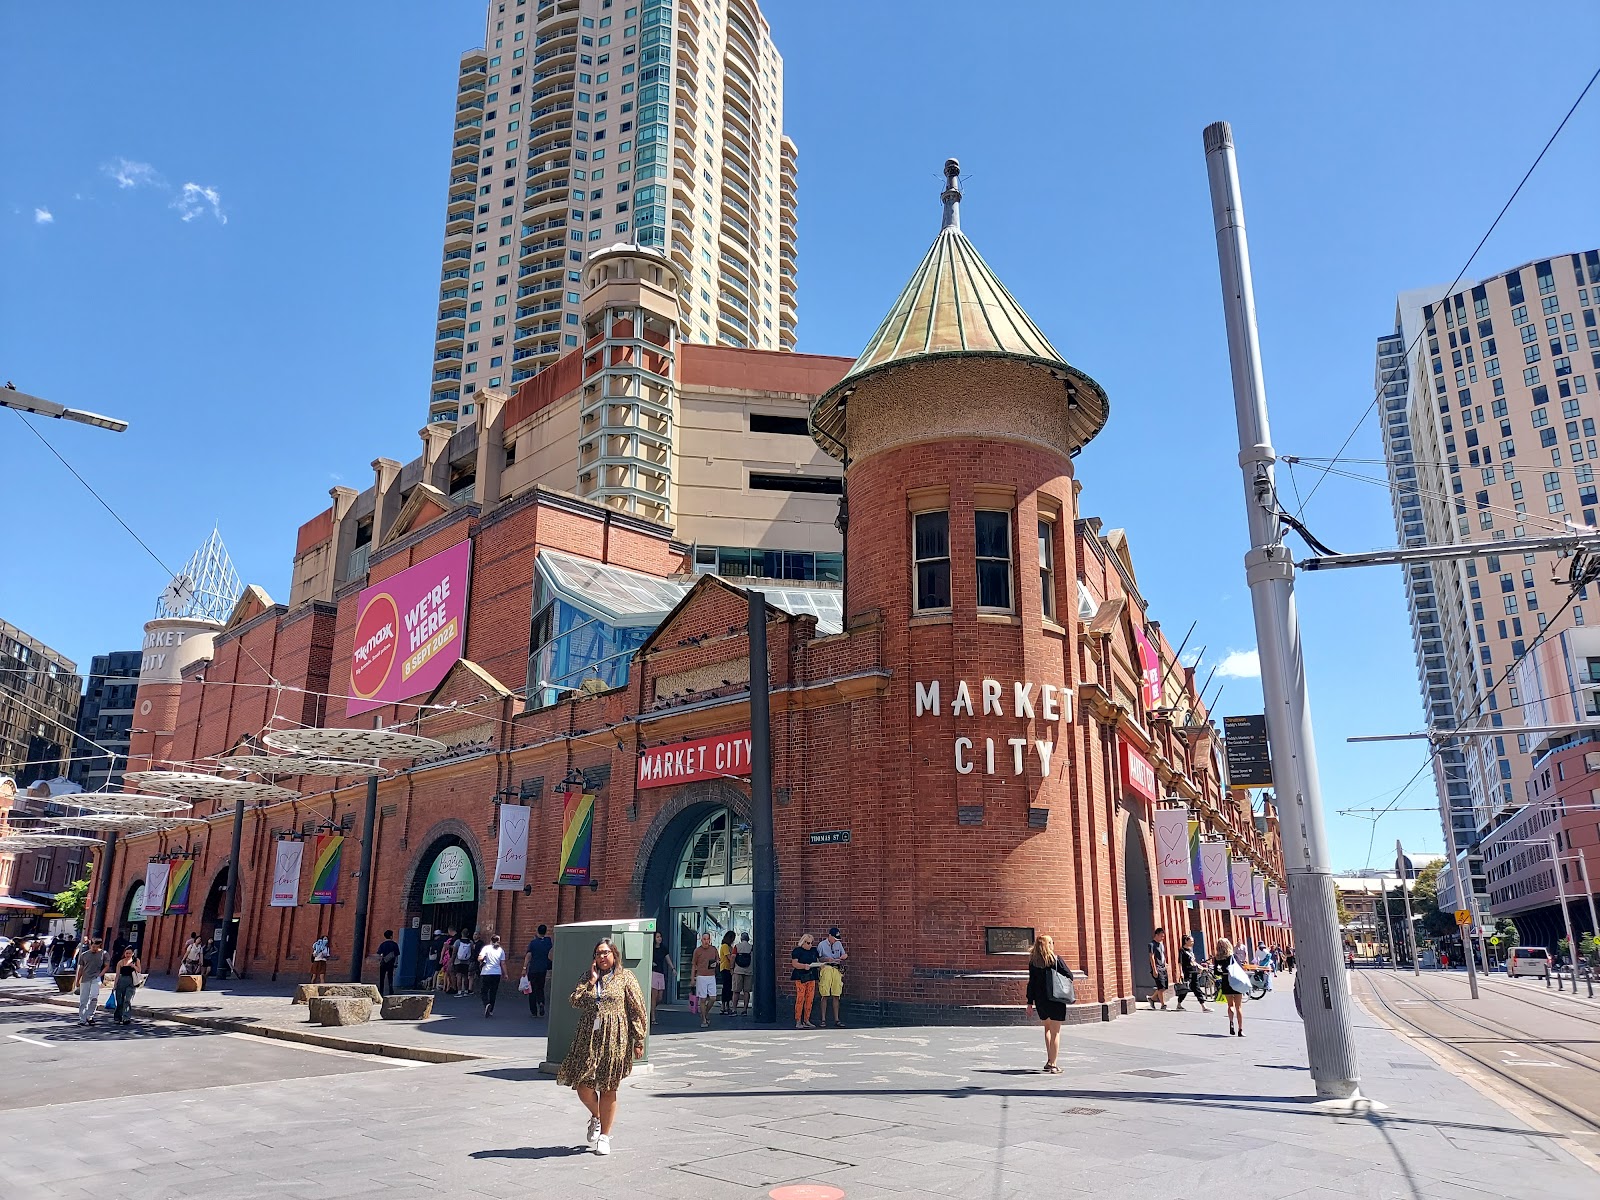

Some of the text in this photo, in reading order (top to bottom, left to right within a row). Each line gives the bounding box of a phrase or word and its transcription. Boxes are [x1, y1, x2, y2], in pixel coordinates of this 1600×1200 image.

[404, 575, 451, 632] WE'RE
[410, 602, 447, 653] HERE
[141, 653, 166, 672] CITY
[404, 623, 455, 676] 8 SEPT 2022
[915, 679, 1074, 724] MARKET
[640, 738, 752, 781] MARKET CITY
[954, 736, 1054, 778] CITY
[498, 847, 527, 863] love
[1157, 853, 1190, 868] love
